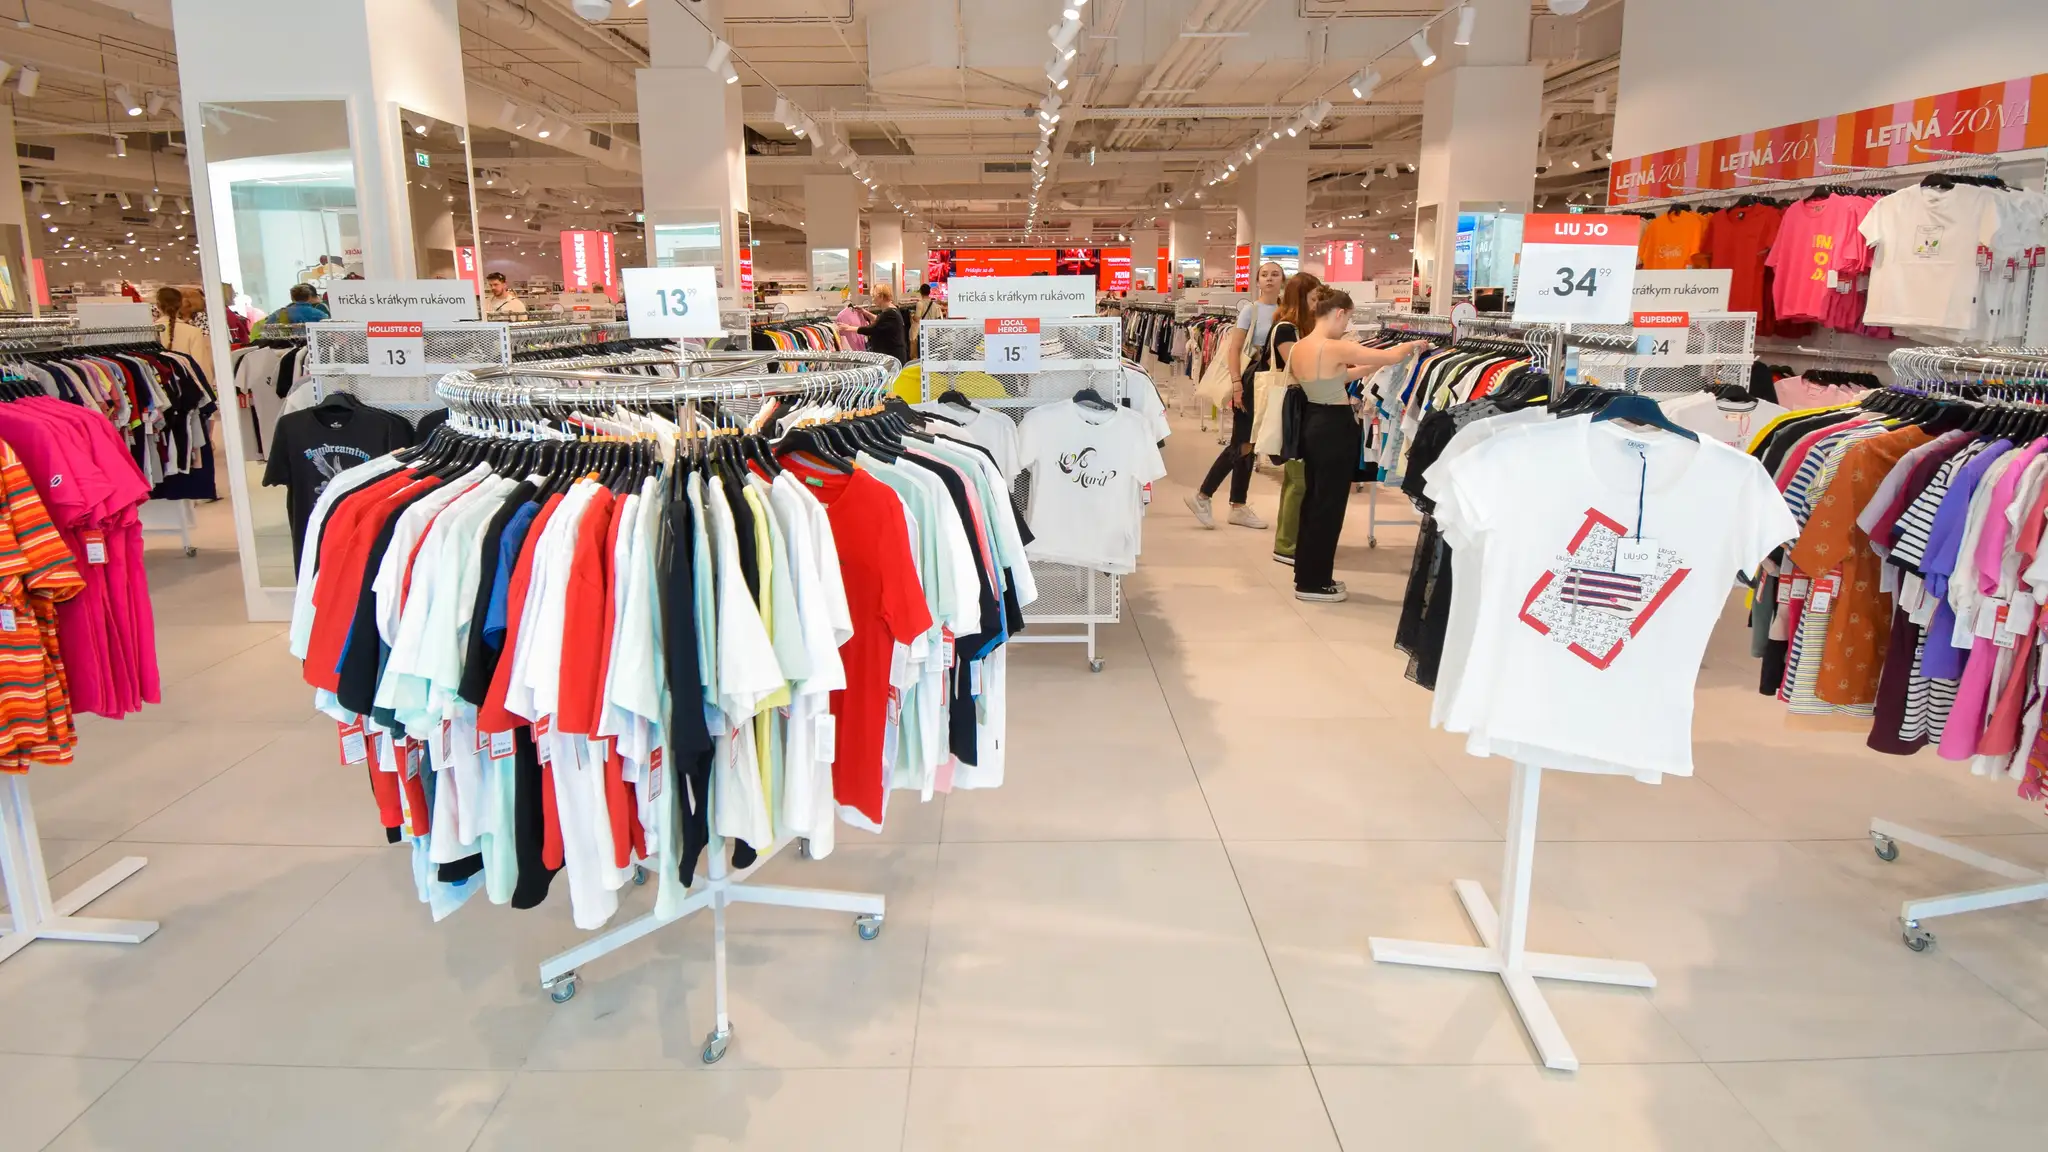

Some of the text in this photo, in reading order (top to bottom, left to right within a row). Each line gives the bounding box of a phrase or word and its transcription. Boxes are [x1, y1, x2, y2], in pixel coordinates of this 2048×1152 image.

[1865, 99, 2030, 149] LETNÁ ZÓNA
[1720, 140, 1774, 172] LETNÁ
[1616, 163, 1656, 190] LETNÁ
[1554, 222, 1609, 237] LIU JO
[1538, 266, 1612, 297] od 34 99
[1673, 283, 1719, 295] rukávom
[338, 293, 466, 307] tričká s krátkym rukávom
[656, 288, 688, 317] 13
[958, 289, 1085, 304] tričká s krátkym rukávom
[1640, 315, 1684, 323] SUPERDRY
[386, 349, 406, 365] 13
[1004, 346, 1020, 362] 15
